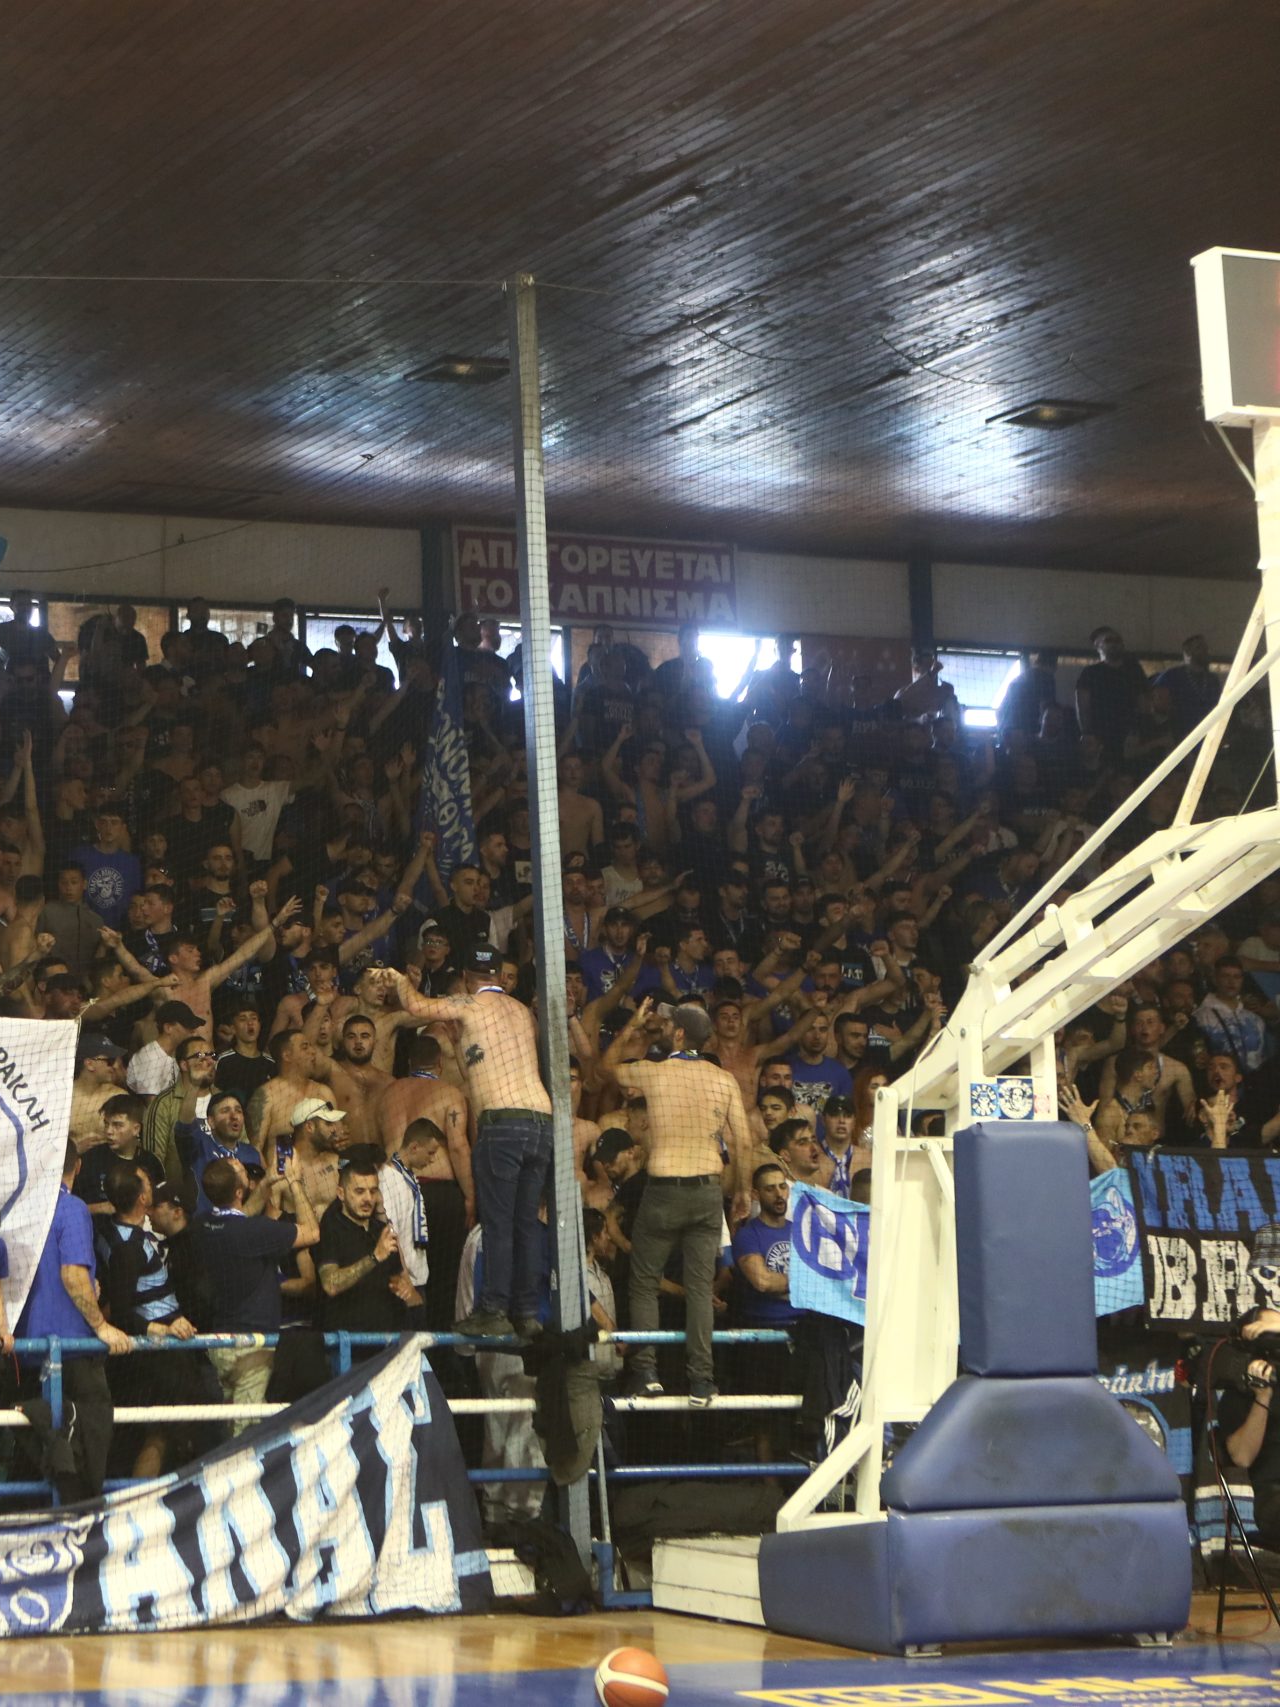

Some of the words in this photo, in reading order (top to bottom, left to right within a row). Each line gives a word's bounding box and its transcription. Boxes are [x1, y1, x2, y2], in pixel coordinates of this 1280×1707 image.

[461, 538, 733, 583] ΑΠΟΡΕΥΕΤΑΙ
[463, 577, 513, 608] ΤΟ
[549, 583, 736, 621] ΑΠΝΙΣΜΑ
